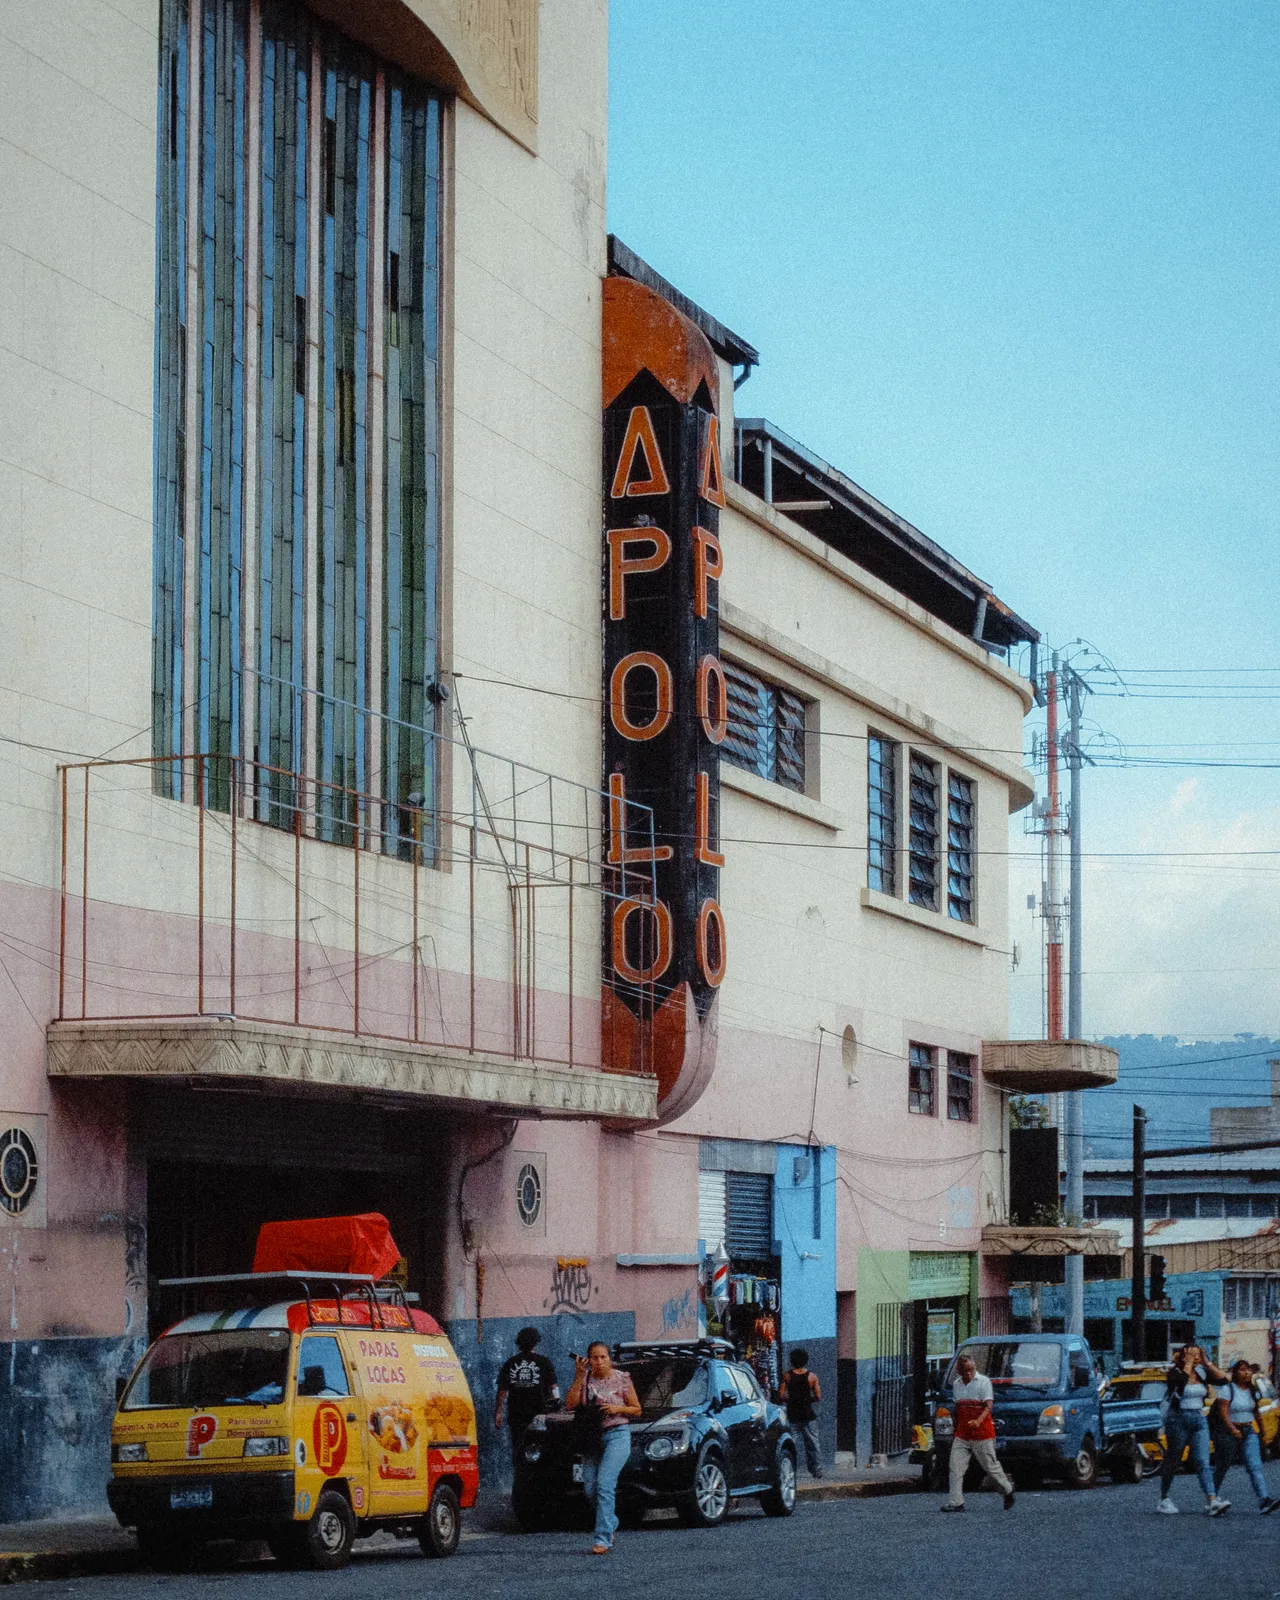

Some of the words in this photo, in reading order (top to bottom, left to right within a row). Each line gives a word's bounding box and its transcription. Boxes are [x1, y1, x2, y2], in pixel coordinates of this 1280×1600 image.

[607, 405, 673, 984] APOLO
[694, 412, 727, 988] APOLO
[359, 1340, 400, 1359] PAPAS
[367, 1365, 406, 1384] LOCAS
